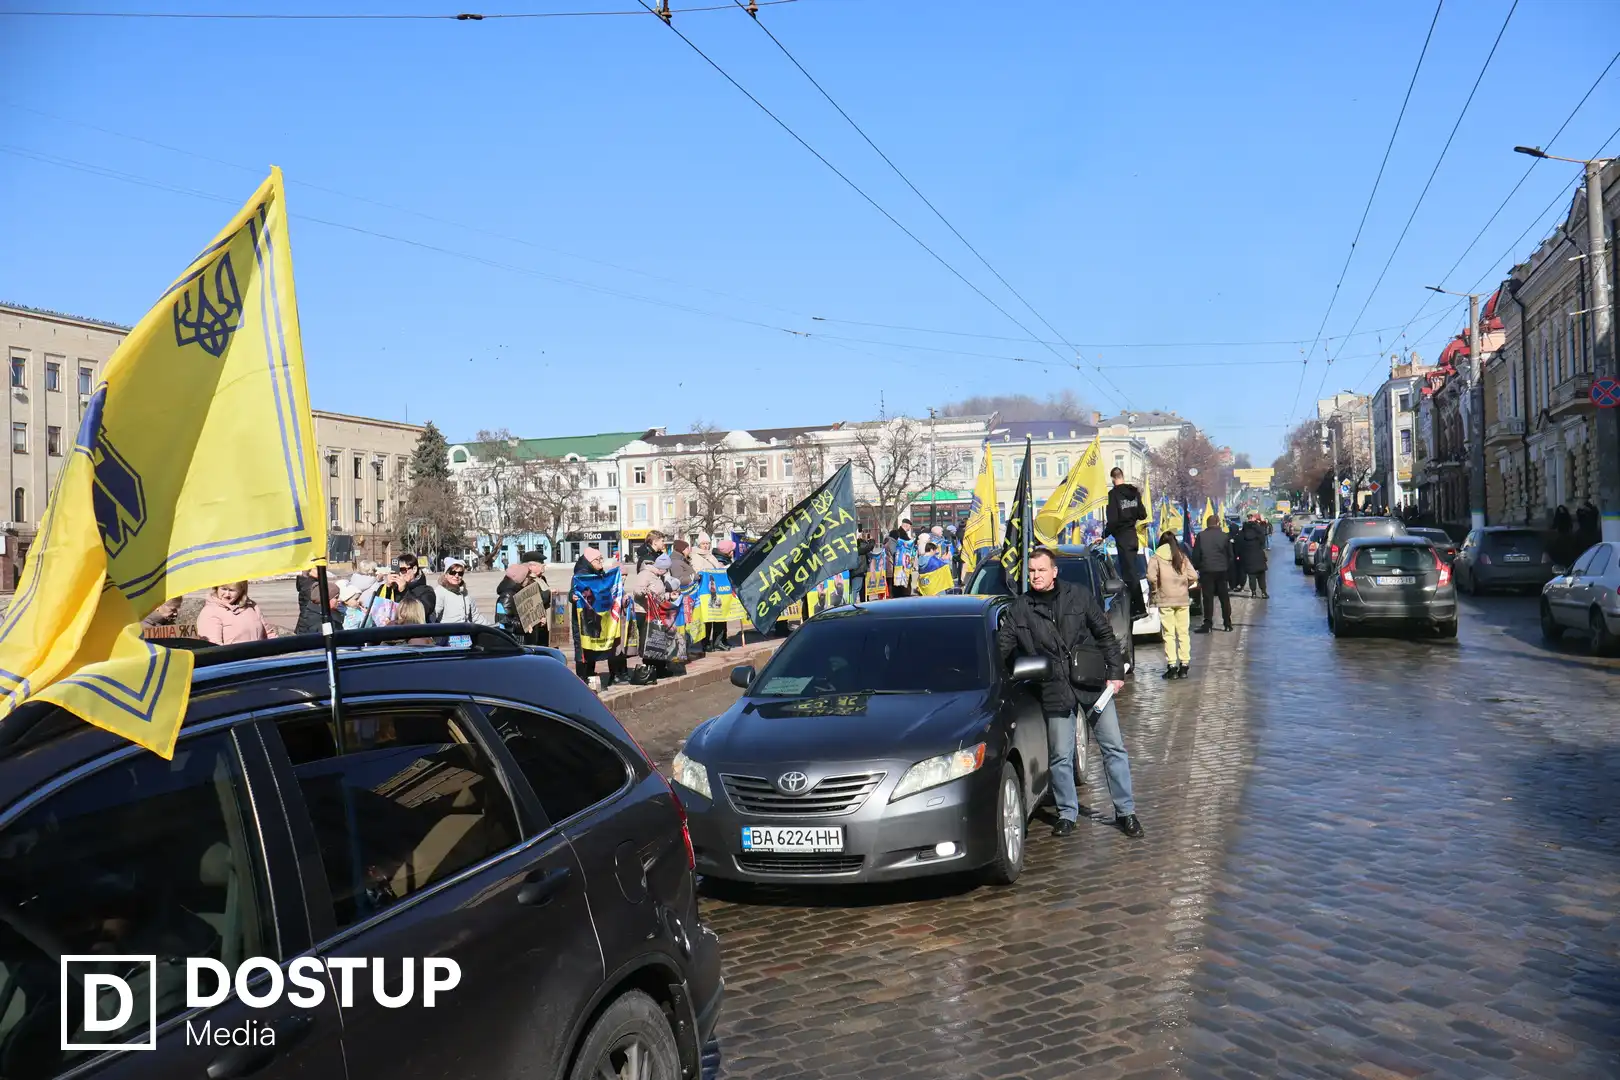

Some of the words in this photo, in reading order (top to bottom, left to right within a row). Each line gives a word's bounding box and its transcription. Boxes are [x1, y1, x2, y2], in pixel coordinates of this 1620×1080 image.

[583, 532, 602, 540] Ябко
[752, 830, 774, 846] BA
[777, 830, 814, 846] 6224
[815, 830, 840, 846] HH
